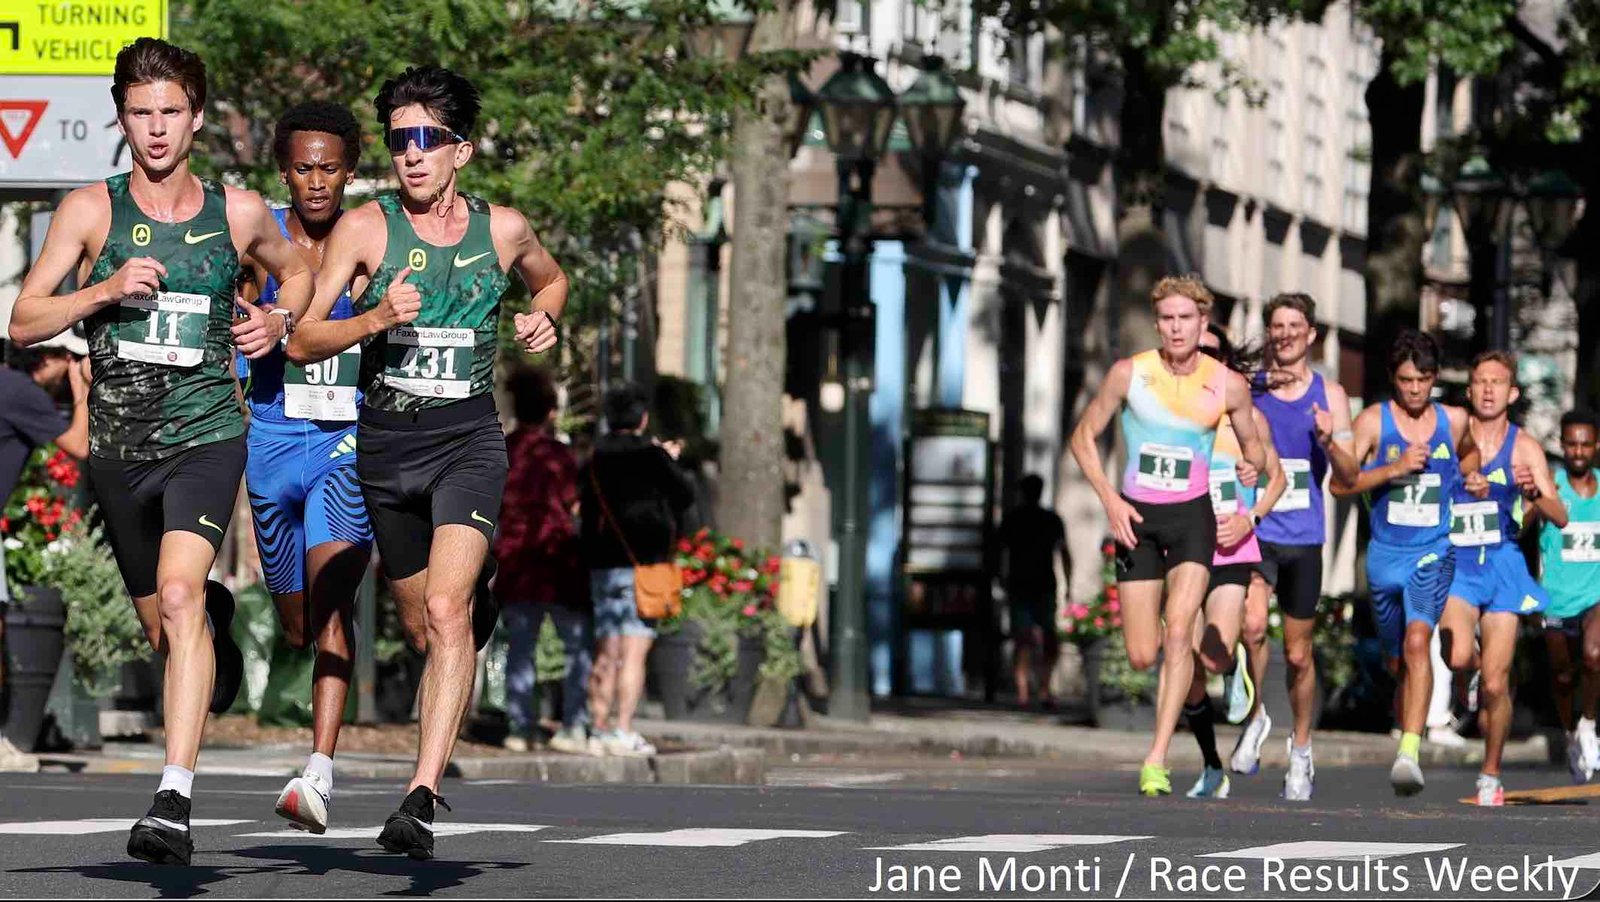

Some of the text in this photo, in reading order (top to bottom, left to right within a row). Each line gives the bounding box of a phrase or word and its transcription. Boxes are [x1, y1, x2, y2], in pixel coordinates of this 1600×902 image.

[38, 4, 146, 25] TURNING
[33, 39, 133, 60] VEHICL
[58, 119, 88, 140] TO
[144, 309, 180, 346] 11
[396, 328, 468, 340] FaxonLawGroup
[305, 355, 339, 385] 50
[400, 347, 457, 379] 431
[1152, 456, 1176, 479] 13
[1403, 484, 1427, 505] 17
[1463, 513, 1486, 534] 18
[1572, 532, 1596, 551] 22
